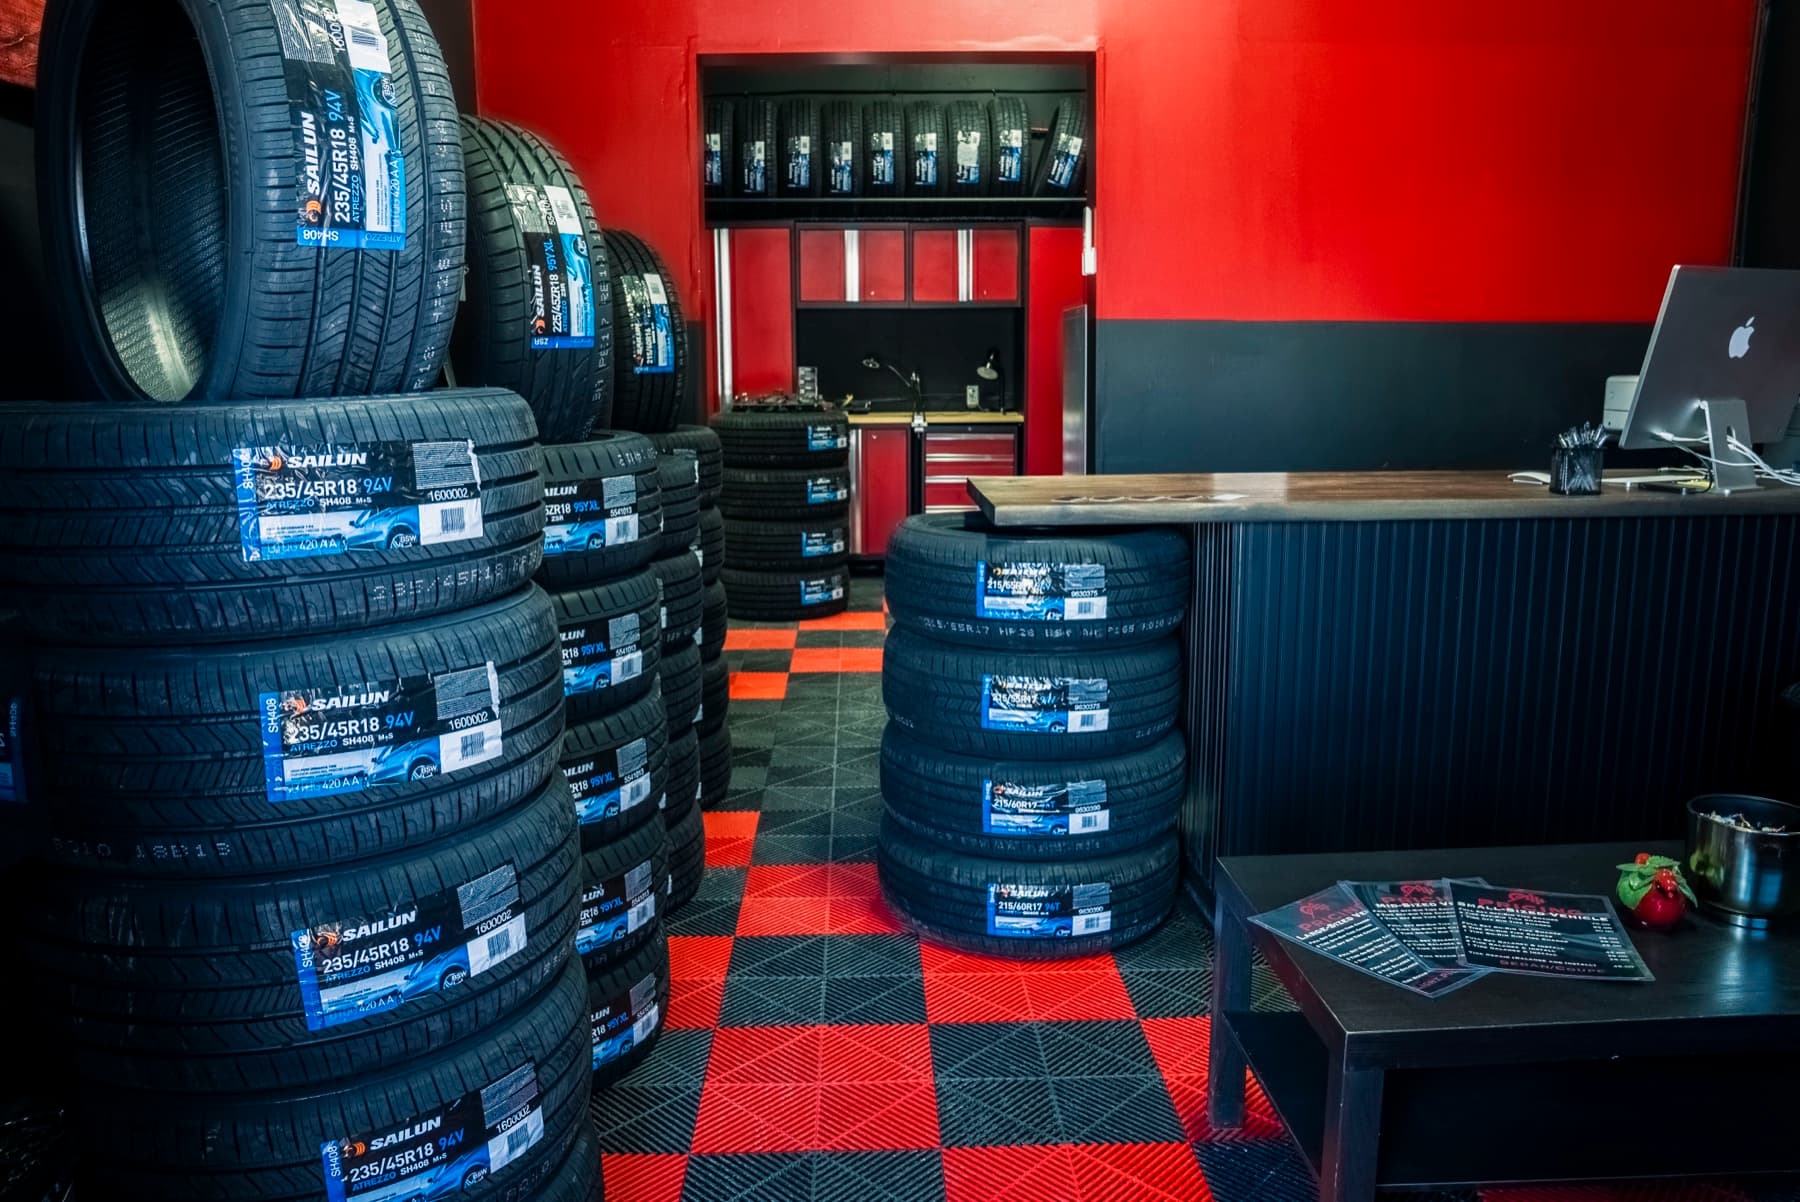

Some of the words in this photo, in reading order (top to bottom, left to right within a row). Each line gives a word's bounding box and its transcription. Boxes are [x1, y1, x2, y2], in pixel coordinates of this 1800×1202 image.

[324, 89, 342, 122] 94V
[301, 111, 320, 196] SAILUN
[349, 136, 359, 171] SH408
[330, 128, 351, 223] 235/45R18
[351, 175, 361, 223] ATREZZO
[303, 230, 339, 241] SH408
[532, 264, 545, 317] SAILUN
[550, 274, 562, 333] 225/45ZR18
[287, 452, 367, 469] SAILUN
[264, 479, 358, 500] 235/45R18
[363, 476, 392, 493] 94V
[428, 487, 469, 502] 1600002
[266, 698, 279, 734] SH408
[311, 690, 390, 712] SAILUN
[290, 716, 380, 744] 235/45R18
[385, 711, 414, 730] 94V
[449, 711, 489, 731] 1600002
[342, 734, 374, 747] SH408
[474, 910, 512, 937] 1600002
[998, 902, 1043, 912] 215/60R17
[342, 910, 416, 942] SAILUN
[322, 937, 410, 974] 235/45R18
[414, 924, 442, 947] 94V
[374, 954, 405, 970] SH408
[370, 1116, 441, 1151] SAILUN
[495, 1104, 532, 1134] 1600002
[330, 1145, 342, 1178] SH408
[350, 1142, 434, 1183] 235/45R18
[438, 1128, 464, 1151] 94V
[352, 1171, 397, 1192] ATREZZO
[400, 1158, 430, 1177] SH408
